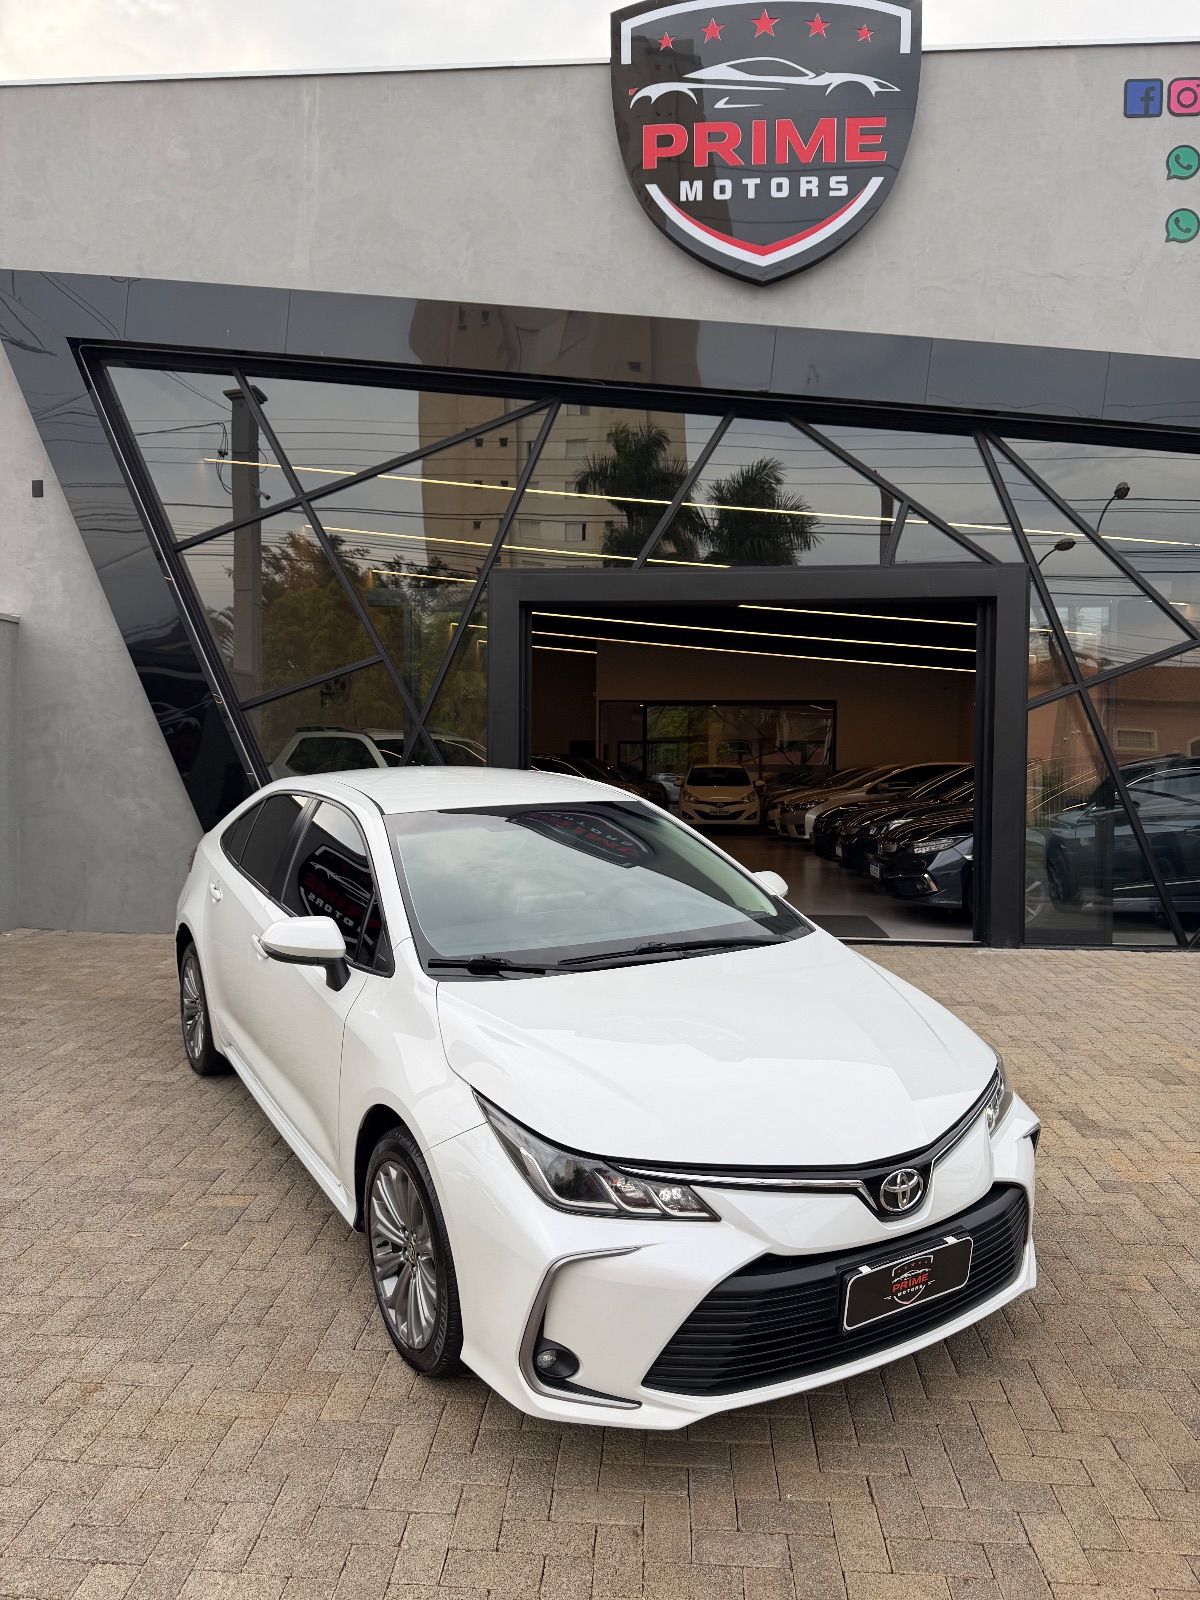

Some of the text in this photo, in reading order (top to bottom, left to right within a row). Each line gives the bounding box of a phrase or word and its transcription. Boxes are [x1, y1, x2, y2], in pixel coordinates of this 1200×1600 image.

[642, 116, 888, 170] PRIME
[679, 175, 849, 203] MOTORS
[892, 1273, 929, 1293] PRIME
[897, 1284, 923, 1297] MOTORS
